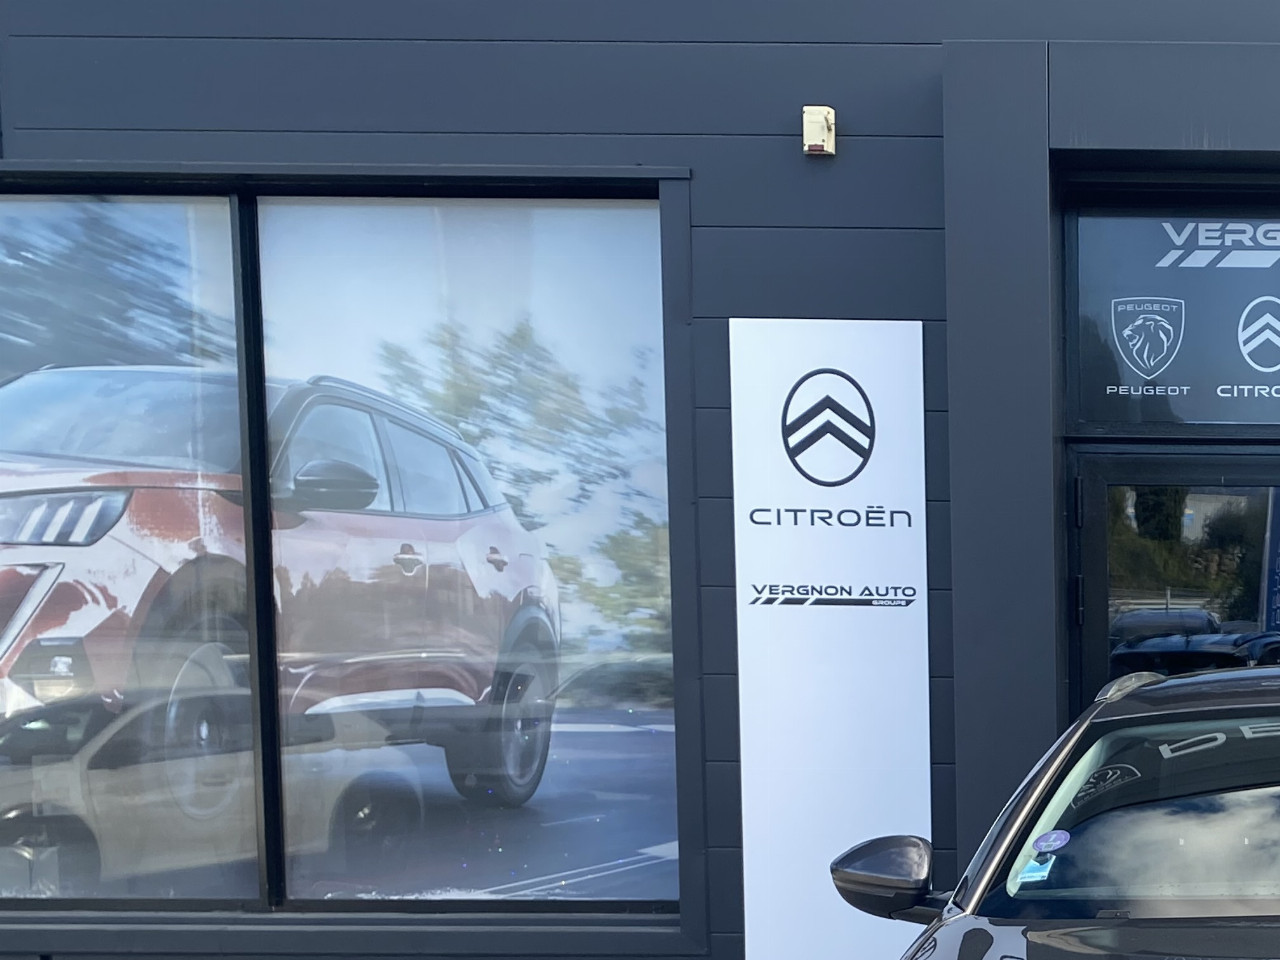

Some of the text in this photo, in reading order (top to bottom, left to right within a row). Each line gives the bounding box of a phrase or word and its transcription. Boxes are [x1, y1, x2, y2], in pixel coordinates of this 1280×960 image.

[1117, 303, 1179, 312] PEUGEOT
[1106, 385, 1191, 396] PEUGEOT
[751, 584, 917, 598] VERGNON AUTO
